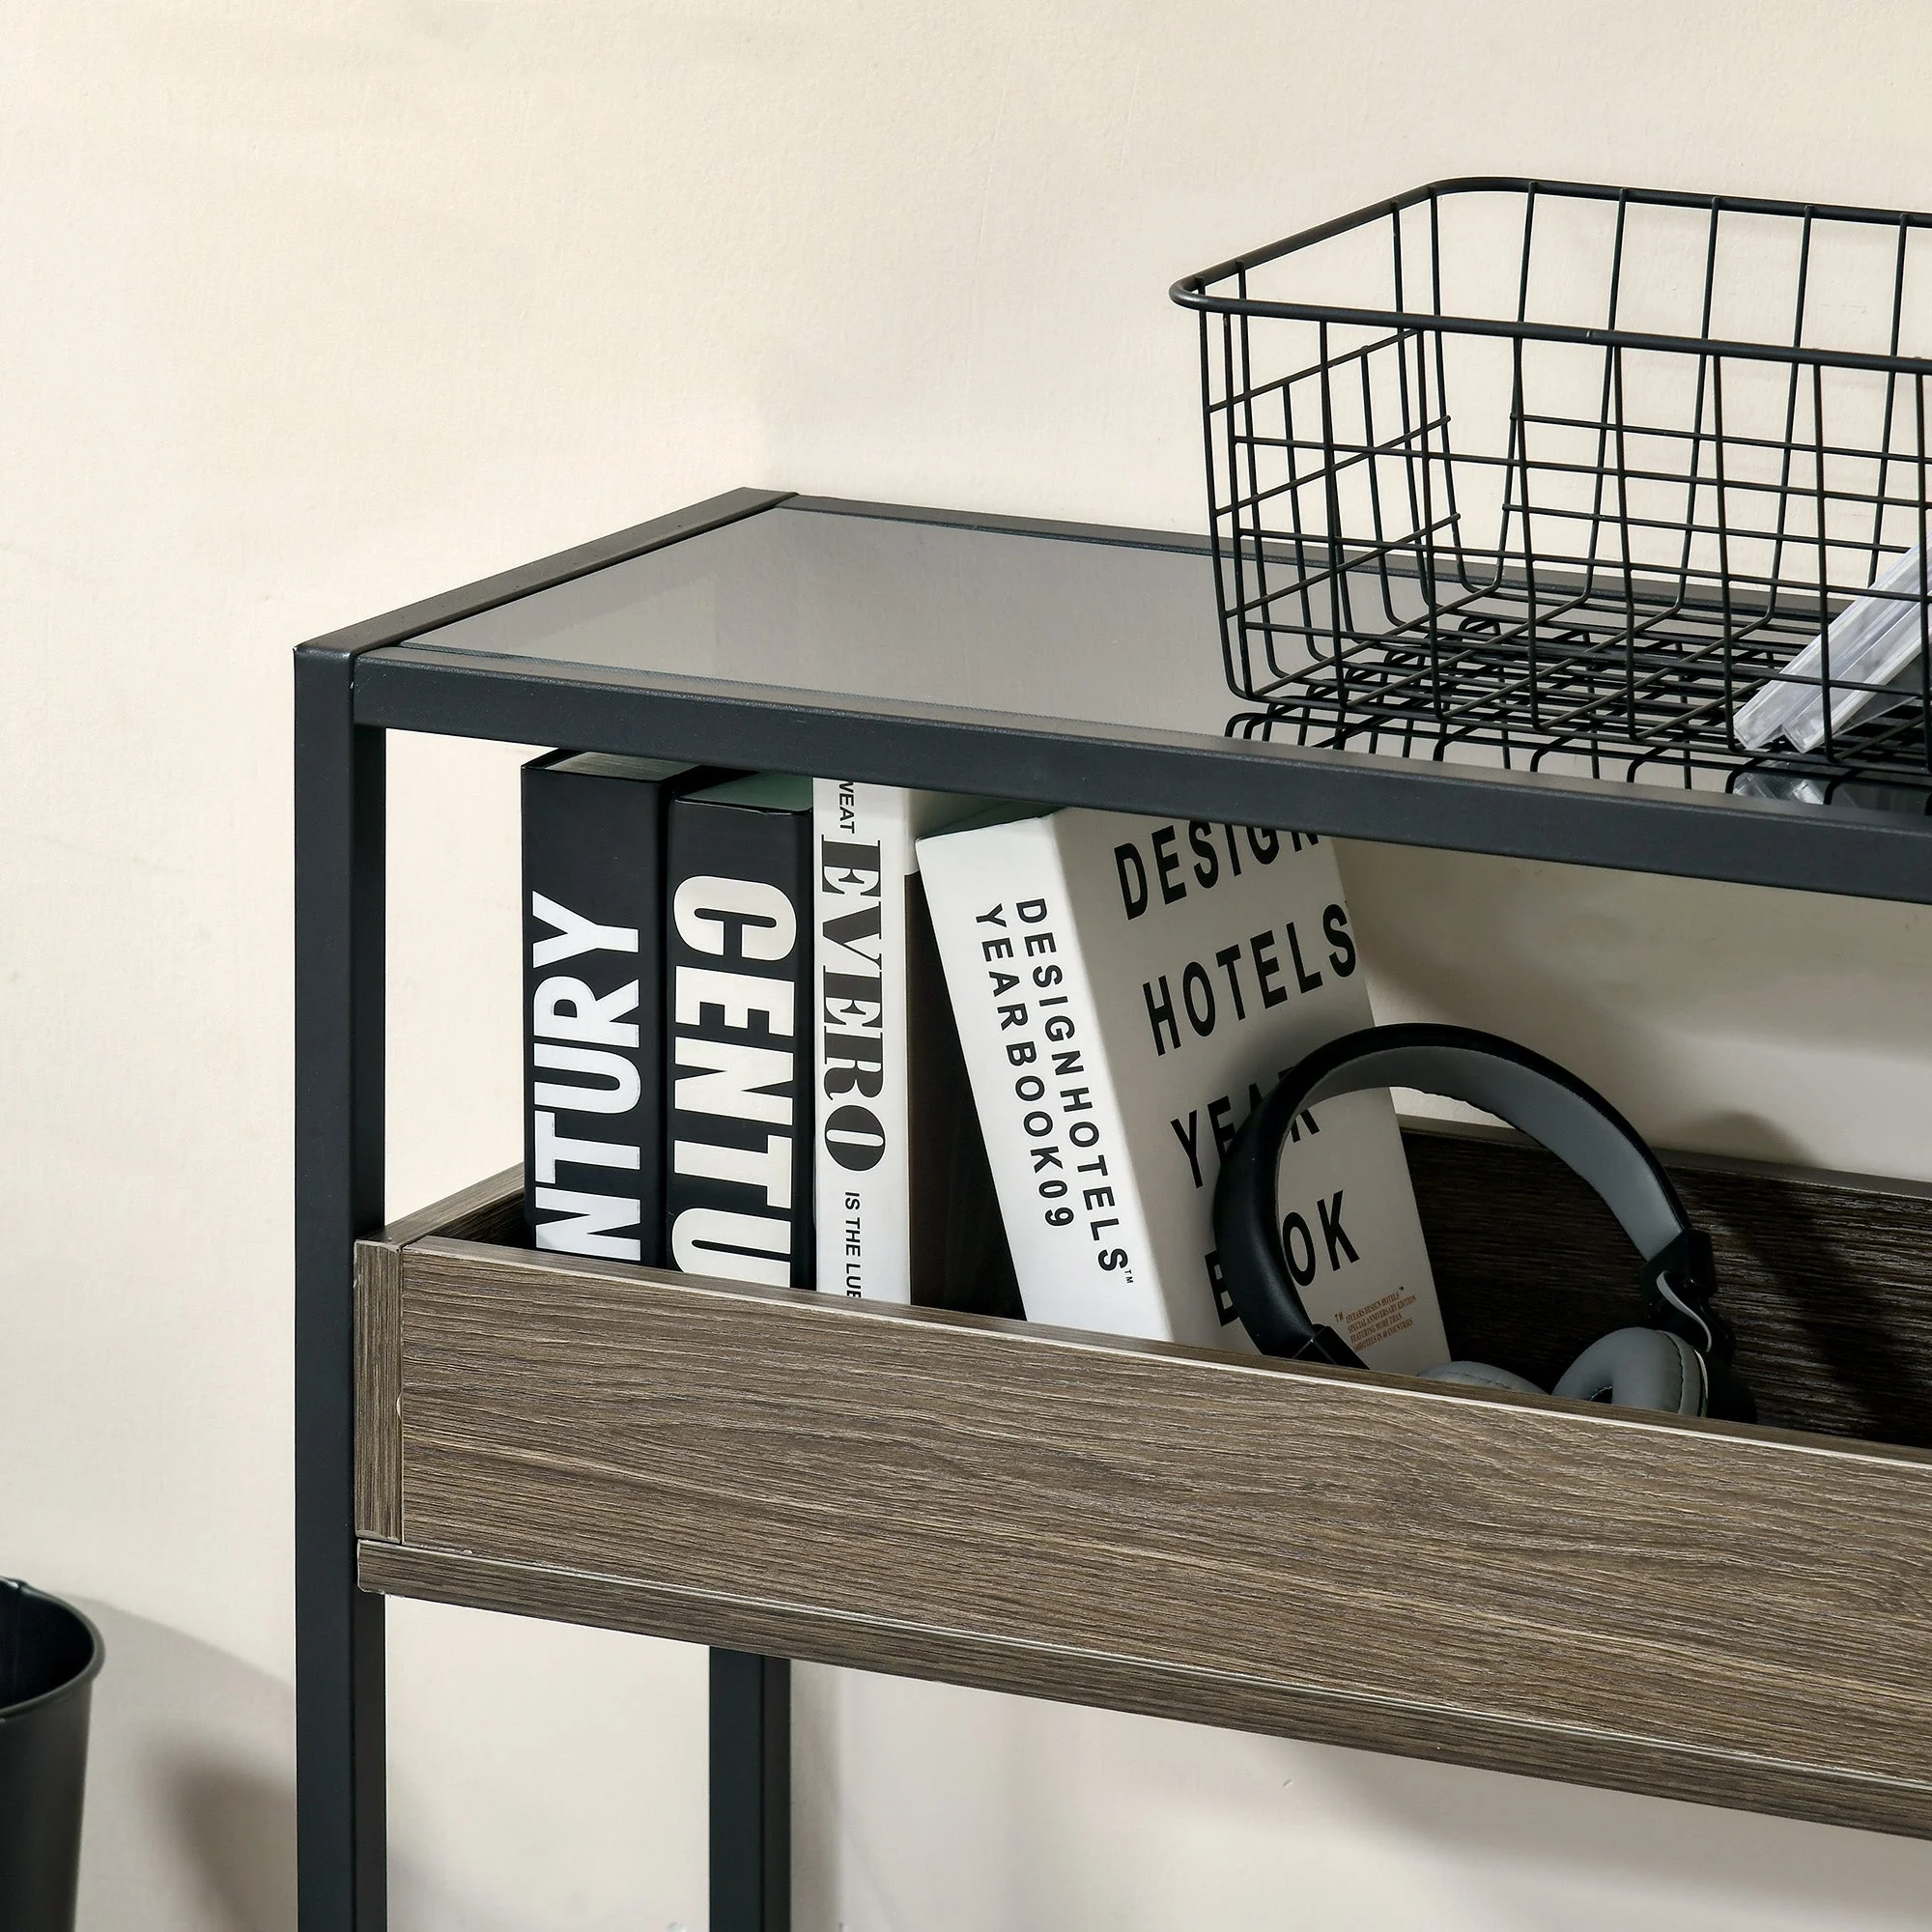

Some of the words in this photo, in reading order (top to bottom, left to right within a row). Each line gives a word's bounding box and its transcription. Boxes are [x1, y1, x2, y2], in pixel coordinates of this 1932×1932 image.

[1114, 819, 1320, 921] DESIG
[821, 835, 886, 1172] EVERO
[1142, 903, 1357, 1056] HOTELS
[531, 891, 641, 1262] NTURY
[671, 874, 797, 1289] CENTU
[844, 1191, 861, 1210] IS
[845, 1217, 861, 1257] THE
